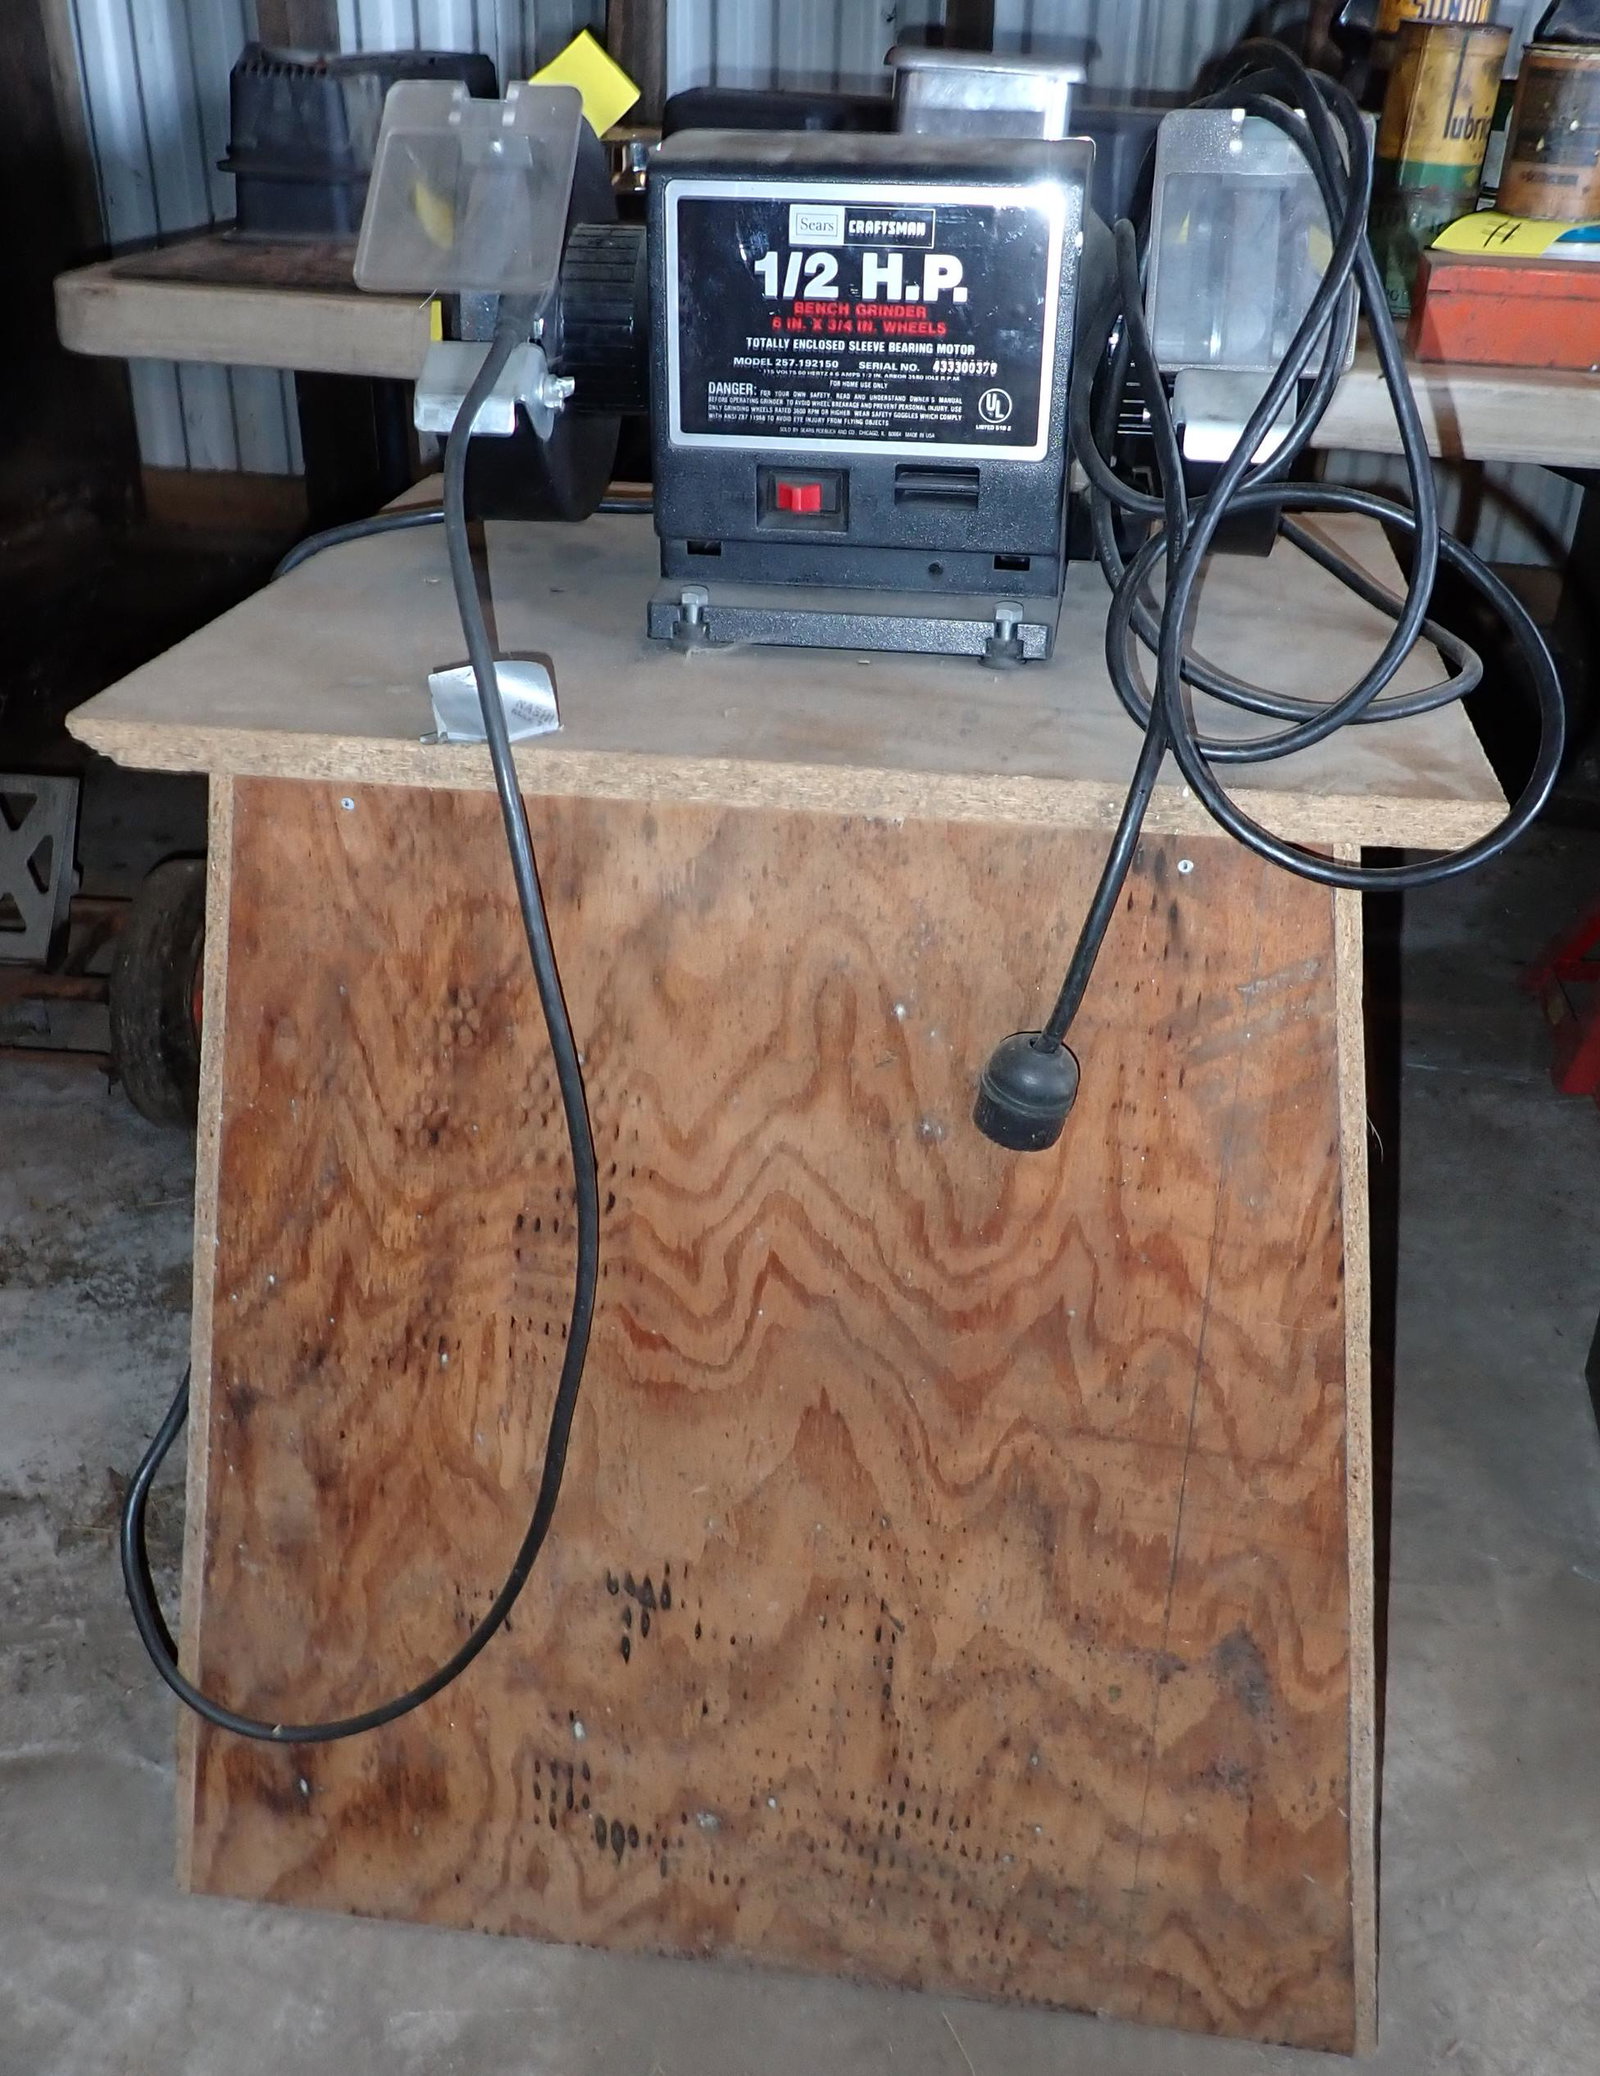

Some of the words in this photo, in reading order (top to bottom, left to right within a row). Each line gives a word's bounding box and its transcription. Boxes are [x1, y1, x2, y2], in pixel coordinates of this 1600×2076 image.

[800, 217, 834, 232] Sears
[848, 219, 926, 238] CRAFTSMAN
[754, 251, 839, 301] 1/2
[861, 252, 968, 304] H.P.
[794, 302, 850, 316] BENCH
[856, 303, 927, 319] GRINDER
[772, 316, 782, 330] 6
[786, 316, 807, 332] IN.
[810, 318, 824, 332] X
[828, 319, 853, 335] 3/4
[856, 320, 877, 335] IN.
[882, 320, 947, 337] WHEELS
[745, 336, 790, 351] TOTALLY
[792, 338, 845, 353] ENCLOSED
[848, 341, 885, 354] SLEEVE
[888, 342, 934, 356] BEARING
[936, 344, 975, 357] MOTOR
[733, 357, 773, 367] MODEL
[858, 361, 898, 372] SERIAL
[900, 362, 921, 373] NO.
[707, 381, 758, 396] DANGER:
[775, 390, 790, 398] YOUR
[836, 392, 851, 400] READ
[854, 393, 866, 401] AND
[869, 394, 907, 402] UNDERSTAND
[938, 396, 963, 405] MANUAL
[829, 379, 841, 387] FOR
[842, 380, 859, 388] HOME
[860, 381, 872, 389] USE
[873, 382, 888, 390] ONLY
[708, 396, 729, 404] BEFORE
[729, 397, 760, 405] OPERATING
[794, 398, 811, 407] AVOID
[812, 399, 831, 408] WHEEL
[831, 400, 860, 409] BREAKAGE
[873, 402, 897, 410] PREVENT
[898, 402, 926, 411] PERSONAL
[950, 404, 963, 413] USE
[708, 404, 722, 412] ONLY
[723, 404, 750, 413] GRINDING
[750, 406, 774, 414] WHEELS
[774, 406, 792, 414] RATED
[854, 410, 870, 418] WEAR
[871, 410, 892, 419] SAFETY
[893, 411, 919, 420] GOGGLES
[919, 412, 939, 421] WHICH
[940, 413, 963, 422] COMPLY
[775, 415, 792, 424] AVOID
[804, 416, 826, 425] INJURY
[826, 417, 843, 425] FROM
[843, 417, 864, 426] FLYING
[864, 418, 889, 427] OBJECTS
